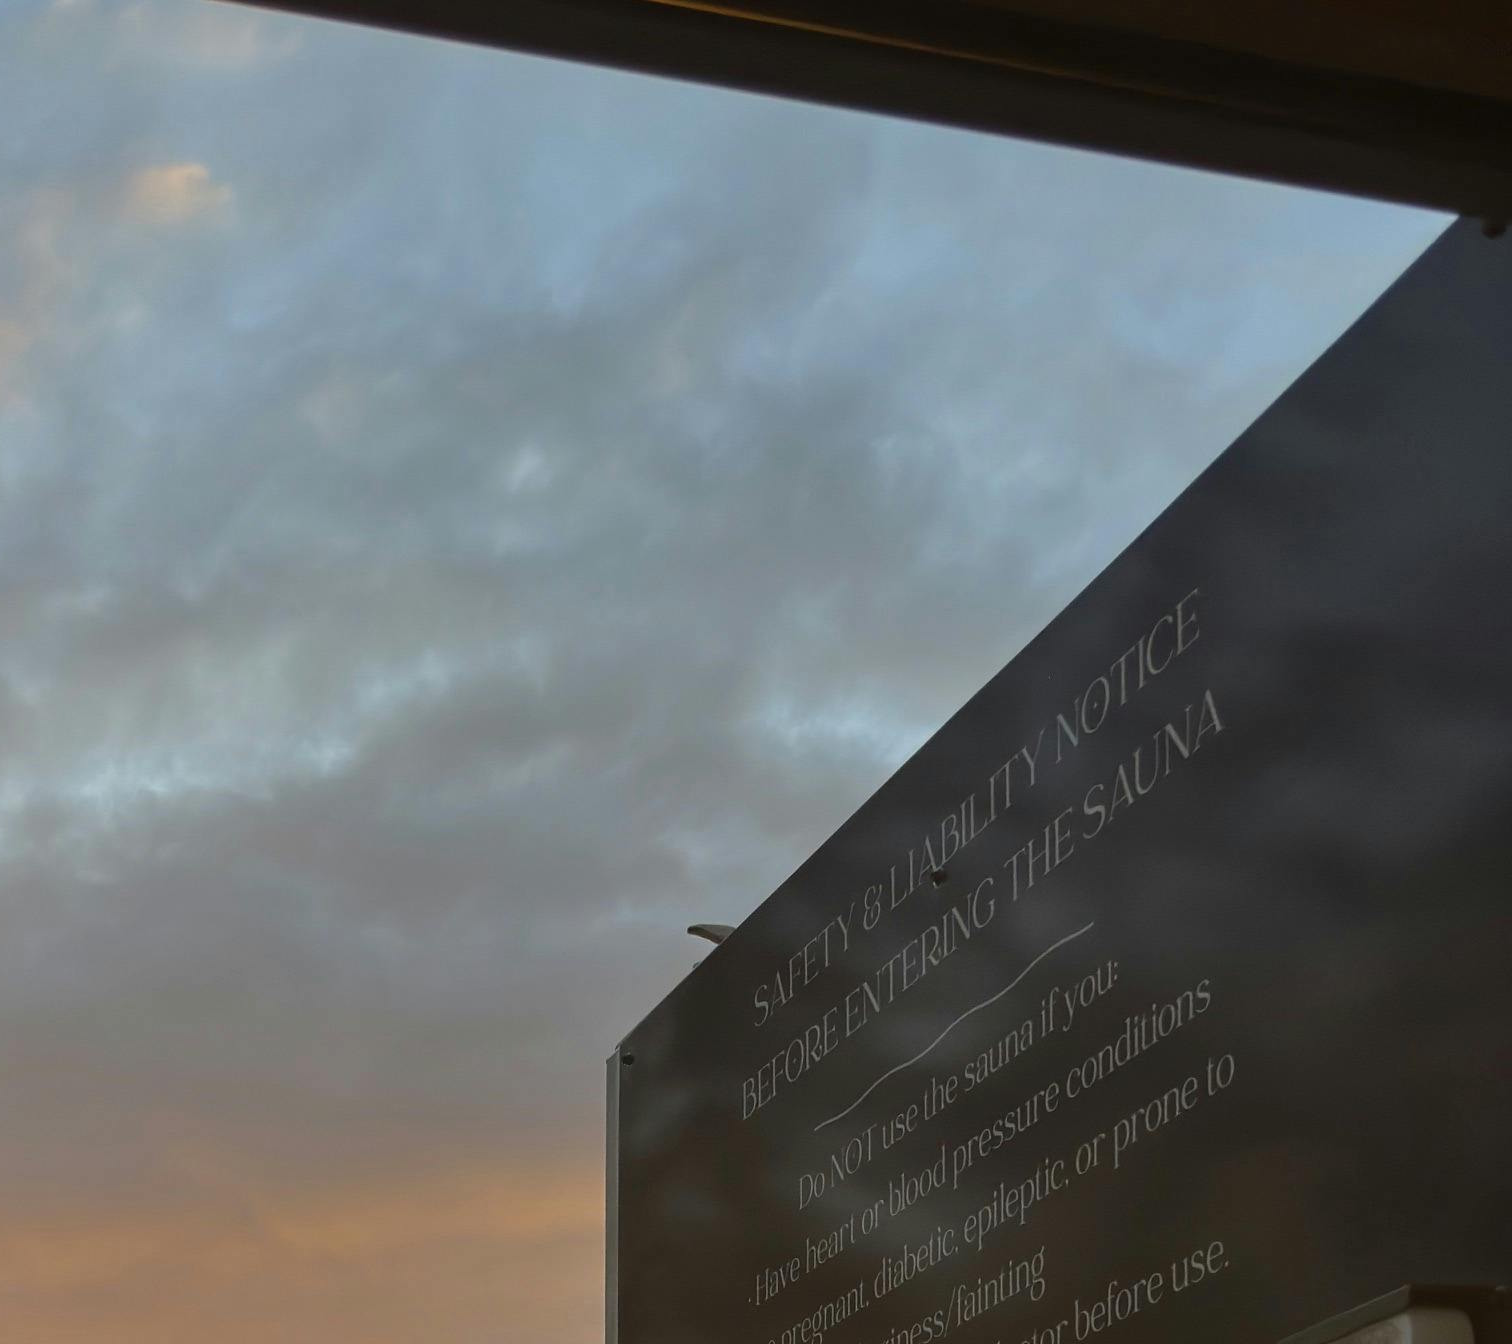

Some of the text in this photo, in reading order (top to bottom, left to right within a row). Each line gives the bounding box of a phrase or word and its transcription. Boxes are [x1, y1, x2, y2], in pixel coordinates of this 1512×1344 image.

[743, 689, 1224, 1120] BEFORE ENTERING THE SAUNA
[754, 588, 1199, 1026] SAFETY & LIABILITY NOTICE
[755, 979, 1211, 1306] Have heart or blood pressure conditions
[799, 960, 1118, 1210] Do NOT use the sauna if you:
[1076, 1133, 1106, 1175] or
[1114, 1077, 1198, 1169] prone
[1207, 1054, 1235, 1096] to
[1074, 1273, 1163, 1341] before
[1171, 1241, 1229, 1292] use.
